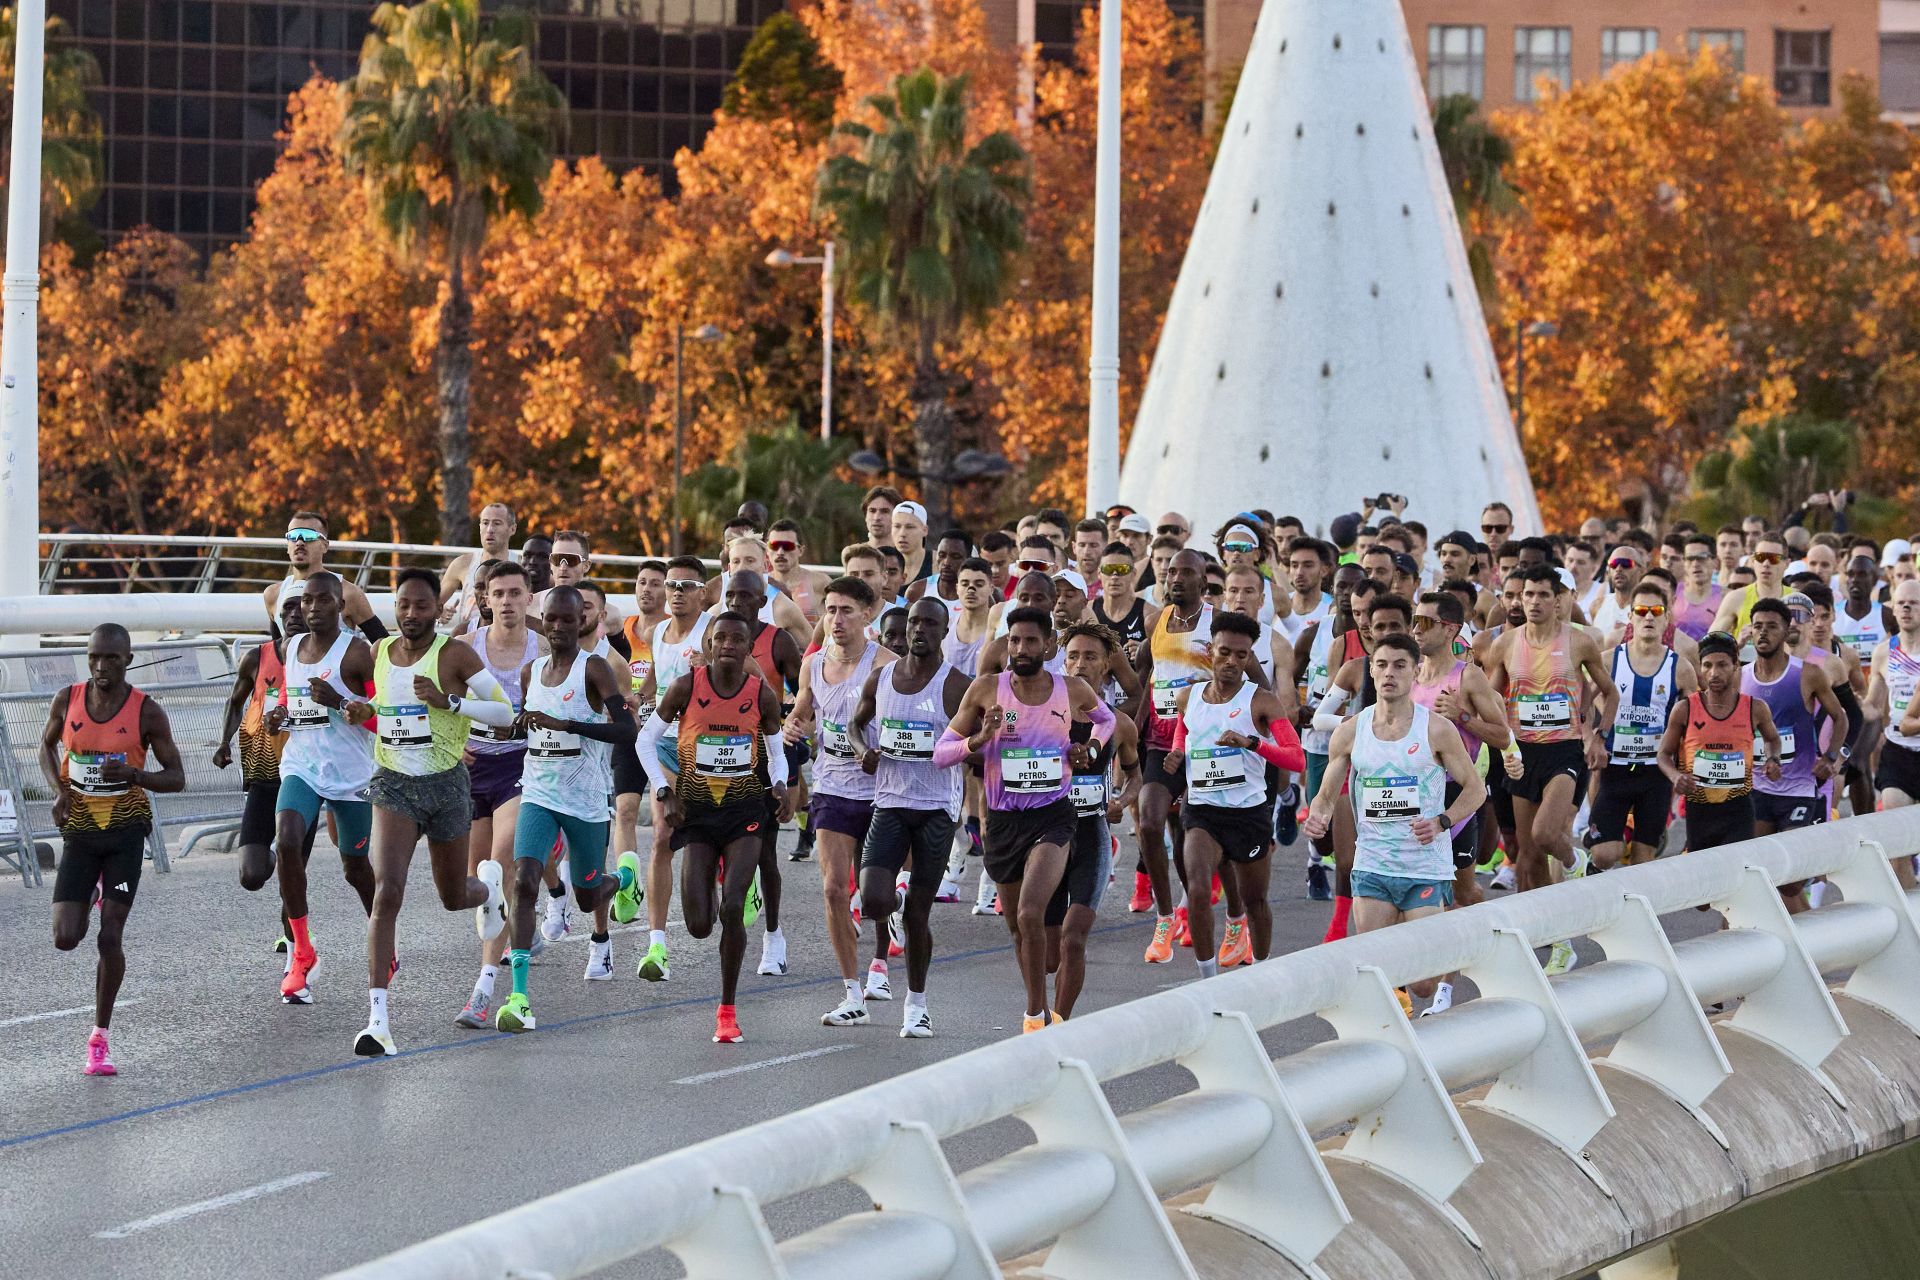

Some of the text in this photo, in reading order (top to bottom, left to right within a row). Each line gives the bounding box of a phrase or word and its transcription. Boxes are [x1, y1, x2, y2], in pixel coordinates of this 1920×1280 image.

[297, 699, 303, 708] 6
[1005, 712, 1017, 721] 96
[1620, 712, 1657, 722] KIROLAK
[395, 718, 402, 727] 9
[391, 729, 410, 737] FITWI
[546, 731, 552, 740] 2
[896, 731, 913, 741] 388
[836, 734, 846, 742] 39
[1633, 736, 1644, 744] 58
[540, 741, 561, 749] KORIR
[893, 741, 916, 750] PACER
[717, 747, 735, 757] 387
[713, 757, 737, 766] PACER
[1026, 760, 1039, 770] 10
[1210, 760, 1217, 769] 8
[1711, 762, 1727, 771] 393
[1018, 771, 1047, 780] PETROS
[1205, 770, 1225, 779] AYALE
[1708, 770, 1730, 778] PACER
[1382, 790, 1392, 798] 22
[1371, 800, 1408, 808] SESEMANN
